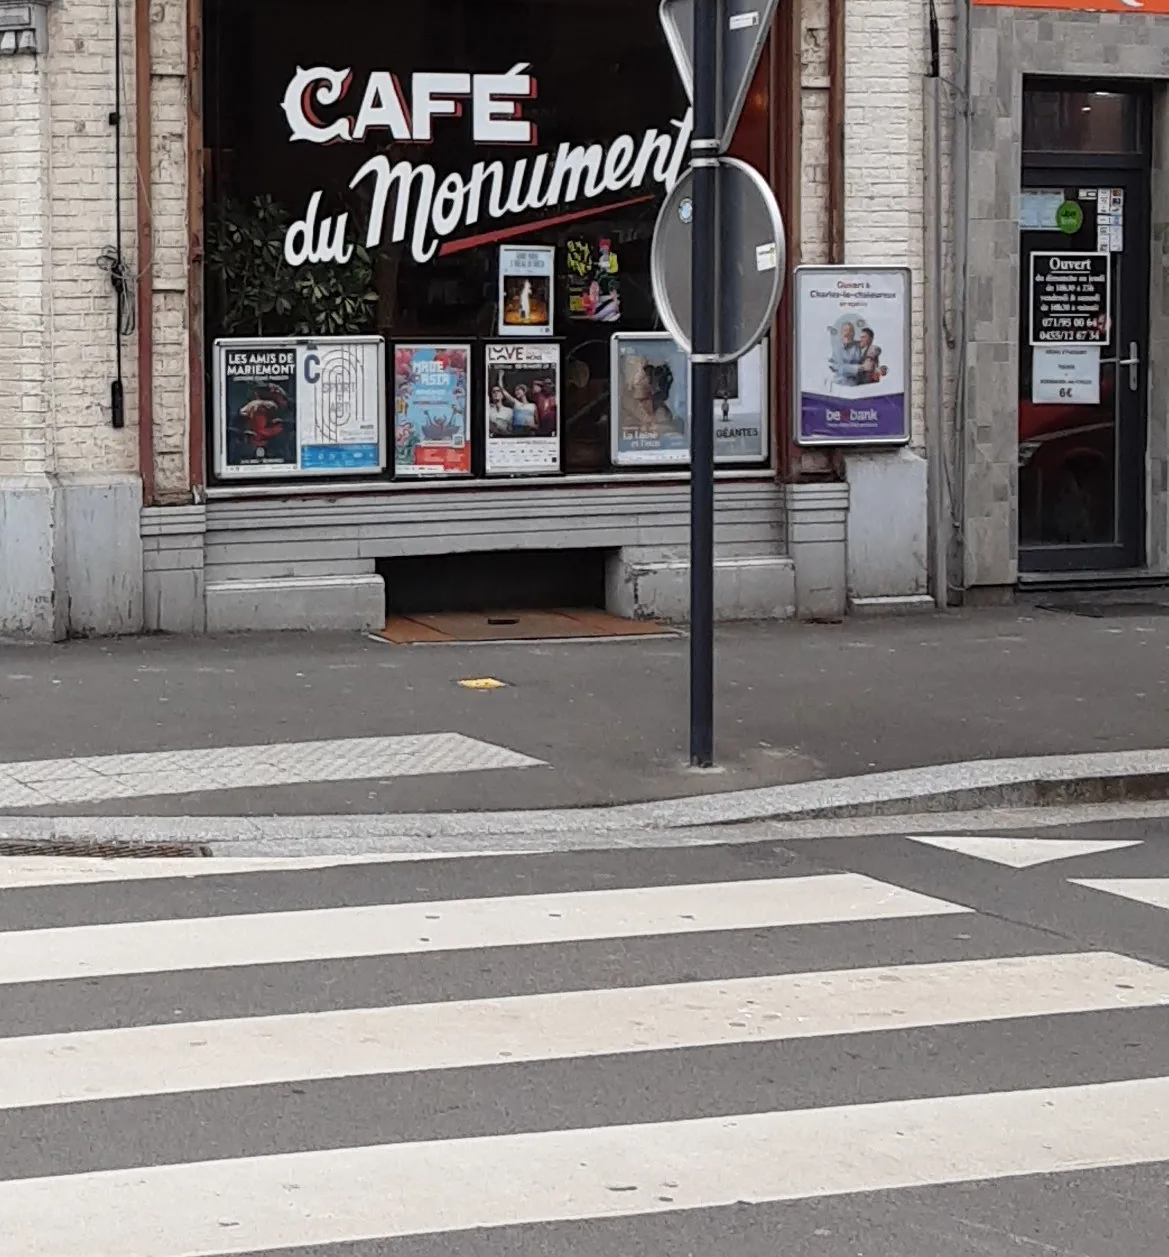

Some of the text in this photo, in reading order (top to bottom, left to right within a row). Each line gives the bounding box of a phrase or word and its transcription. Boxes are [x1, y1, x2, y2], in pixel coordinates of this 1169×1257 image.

[280, 62, 536, 145] CAFÉ
[284, 190, 355, 266] du
[1049, 257, 1092, 270] Ouvert
[228, 353, 294, 364] LES AMIS DE
[227, 363, 295, 375] MARIEMONT
[826, 408, 878, 421] bebank
[716, 427, 759, 438] GÉANTES
